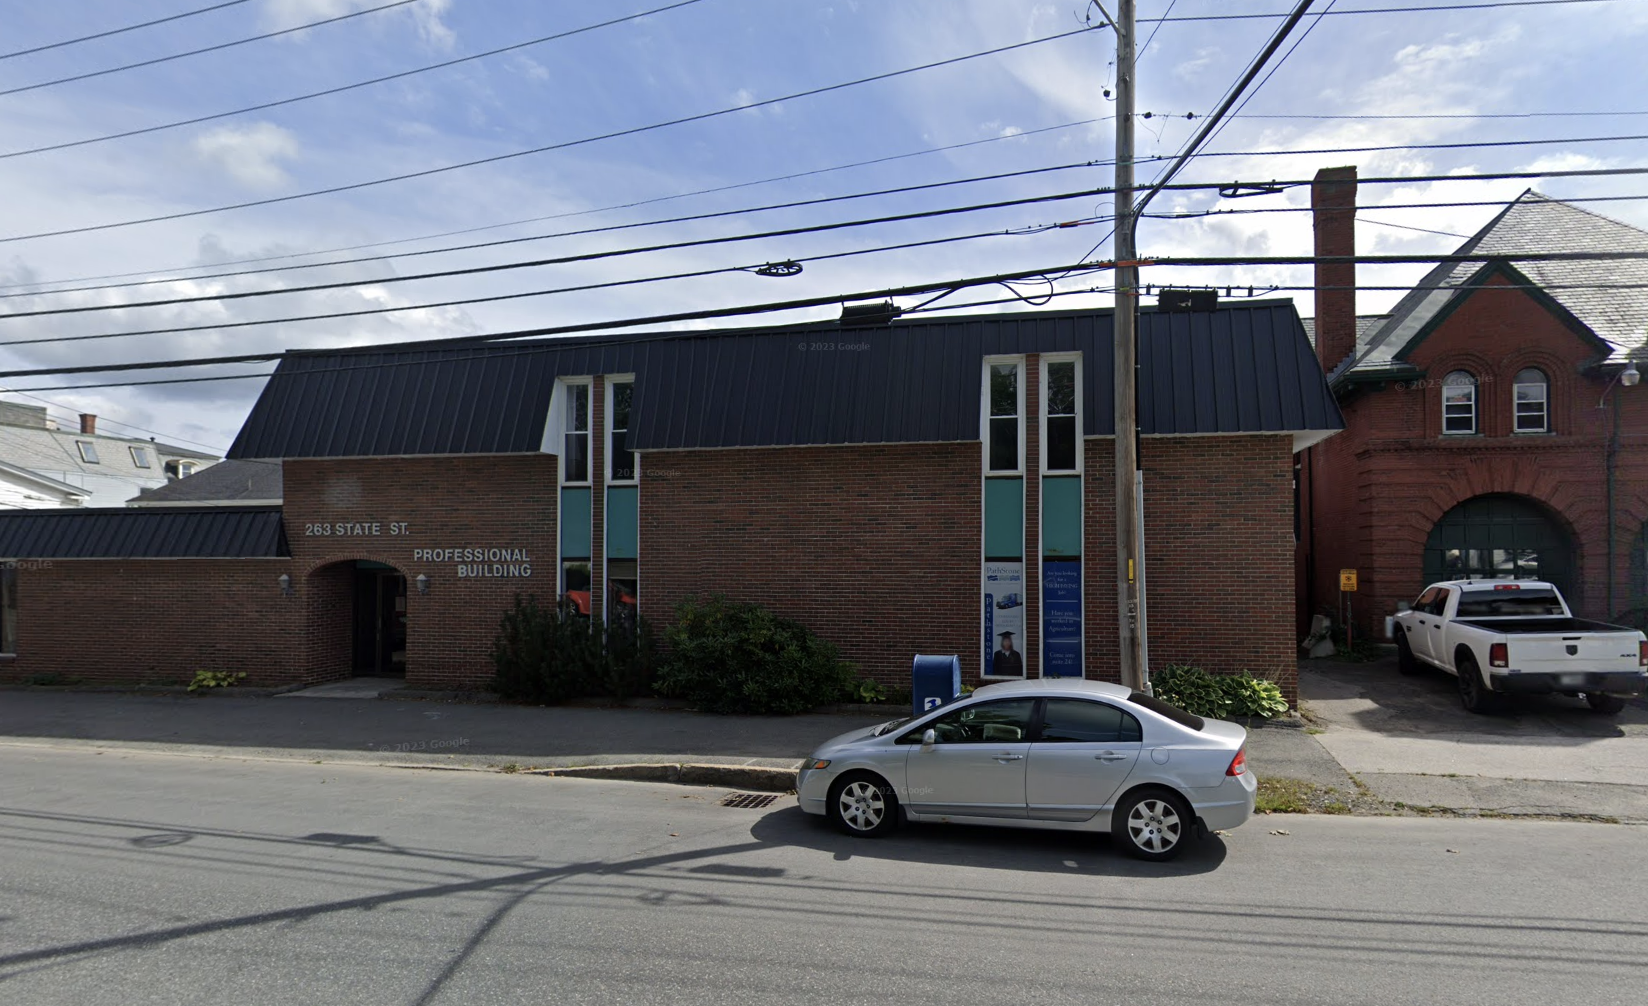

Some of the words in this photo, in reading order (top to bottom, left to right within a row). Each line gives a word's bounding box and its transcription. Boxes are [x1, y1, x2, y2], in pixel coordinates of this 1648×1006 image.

[305, 523, 331, 536] 263
[335, 523, 381, 536] STATE
[389, 522, 410, 535] ST.
[413, 549, 531, 562] PROFESSIONAL
[457, 563, 532, 578] BUILDING
[986, 566, 1020, 574] PathStone
